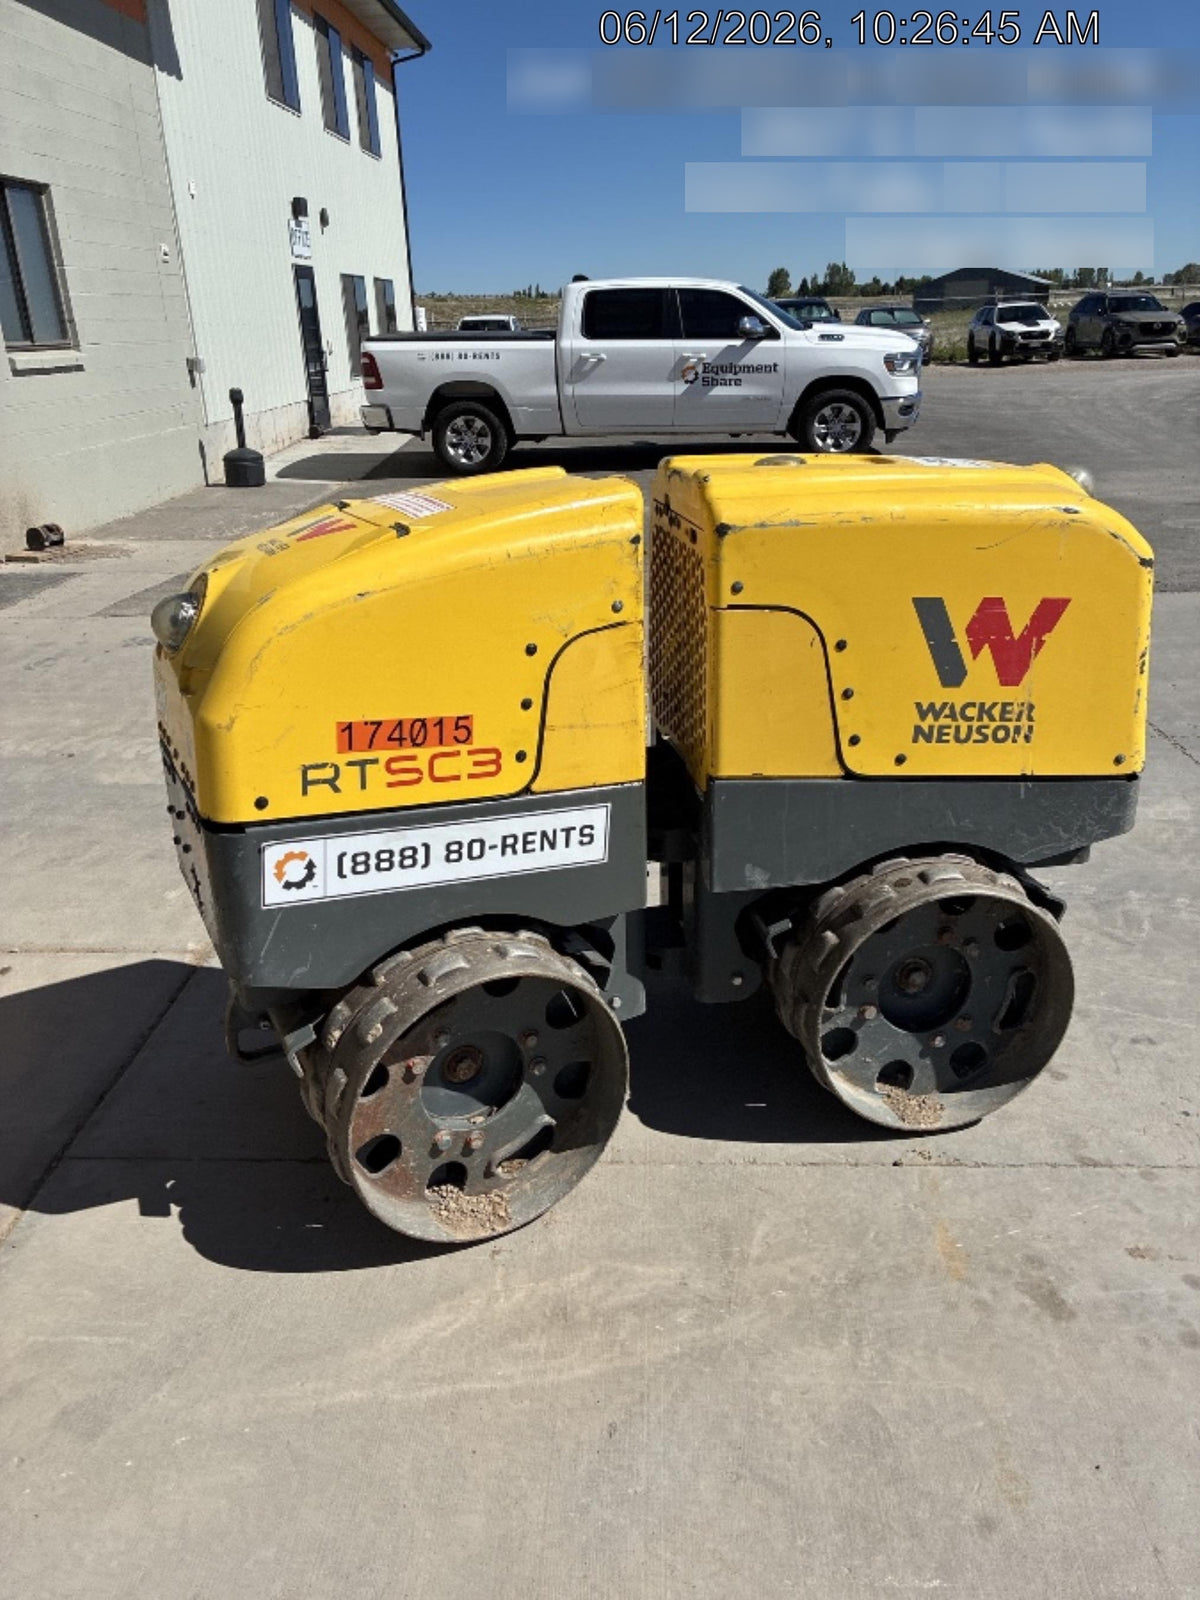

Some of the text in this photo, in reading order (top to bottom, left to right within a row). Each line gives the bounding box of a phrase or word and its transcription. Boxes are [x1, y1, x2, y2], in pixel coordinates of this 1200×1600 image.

[702, 362, 779, 375] Equipment
[702, 376, 742, 387] Share
[914, 702, 1035, 722] WACKER
[340, 716, 472, 750] 174015
[912, 725, 1034, 743] NEUSON
[301, 747, 502, 796] RTSC3
[337, 825, 595, 878] (888) 80-RENTS
